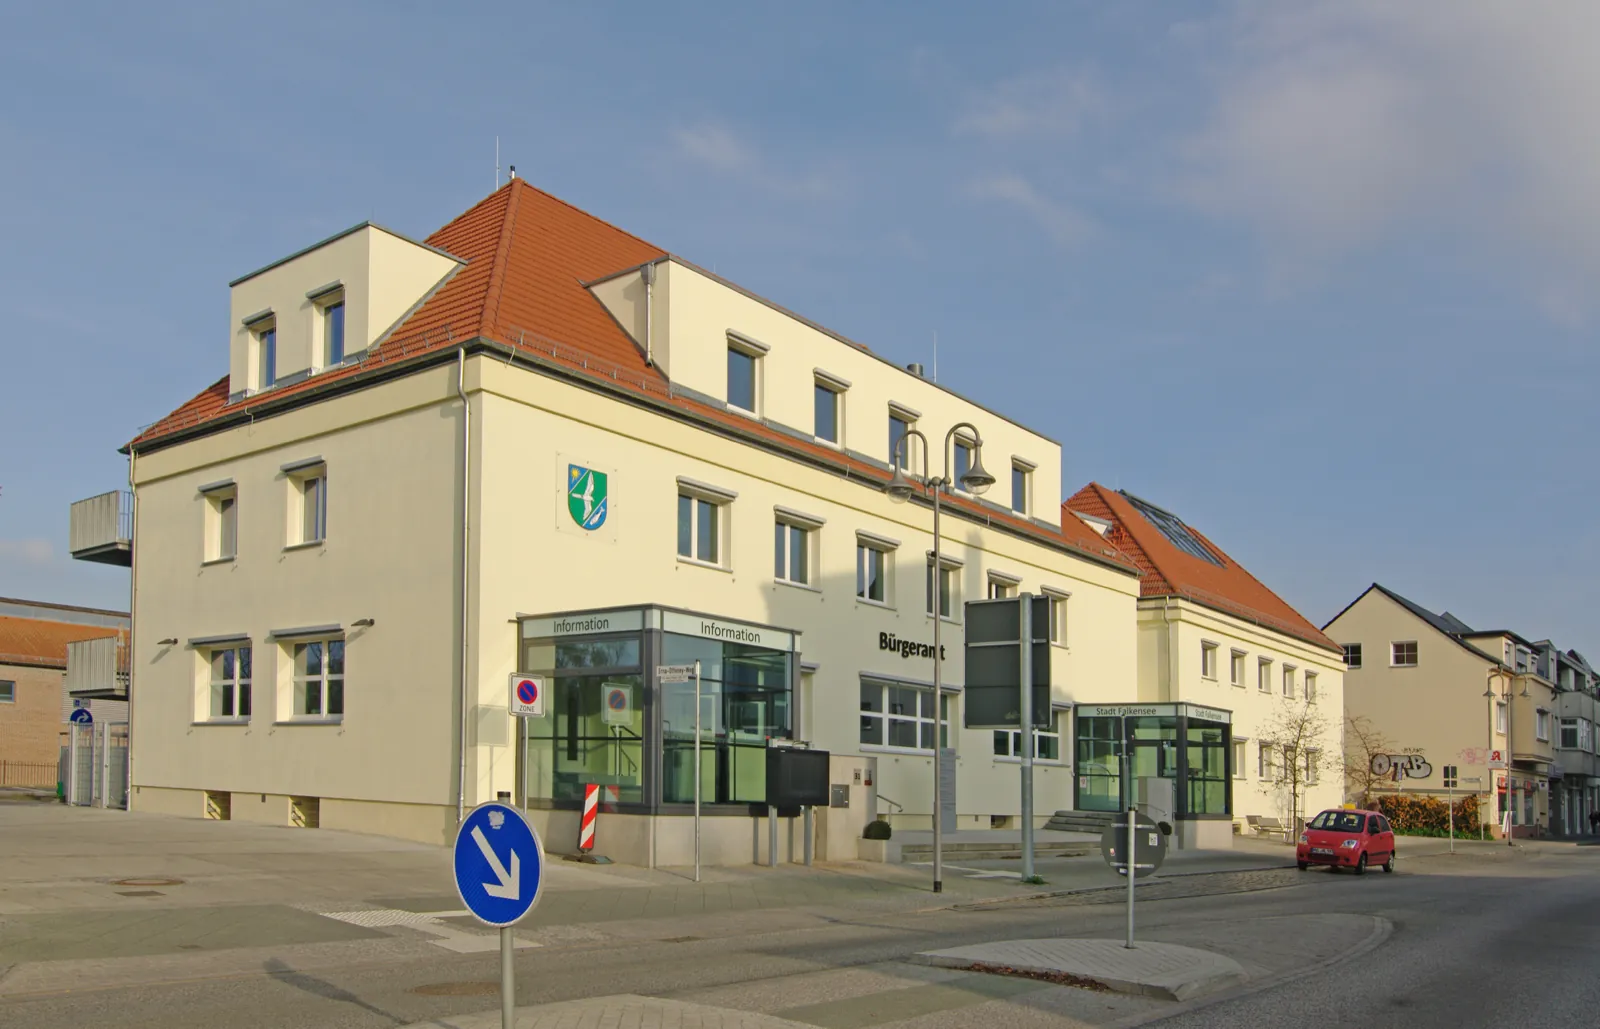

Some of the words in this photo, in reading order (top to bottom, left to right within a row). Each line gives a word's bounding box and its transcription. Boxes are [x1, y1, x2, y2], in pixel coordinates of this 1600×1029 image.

[553, 616, 610, 633] Information
[701, 620, 761, 643] Information
[519, 704, 535, 713] ZONE
[1096, 707, 1116, 716] Stadt
[1118, 706, 1157, 716] Falkensee
